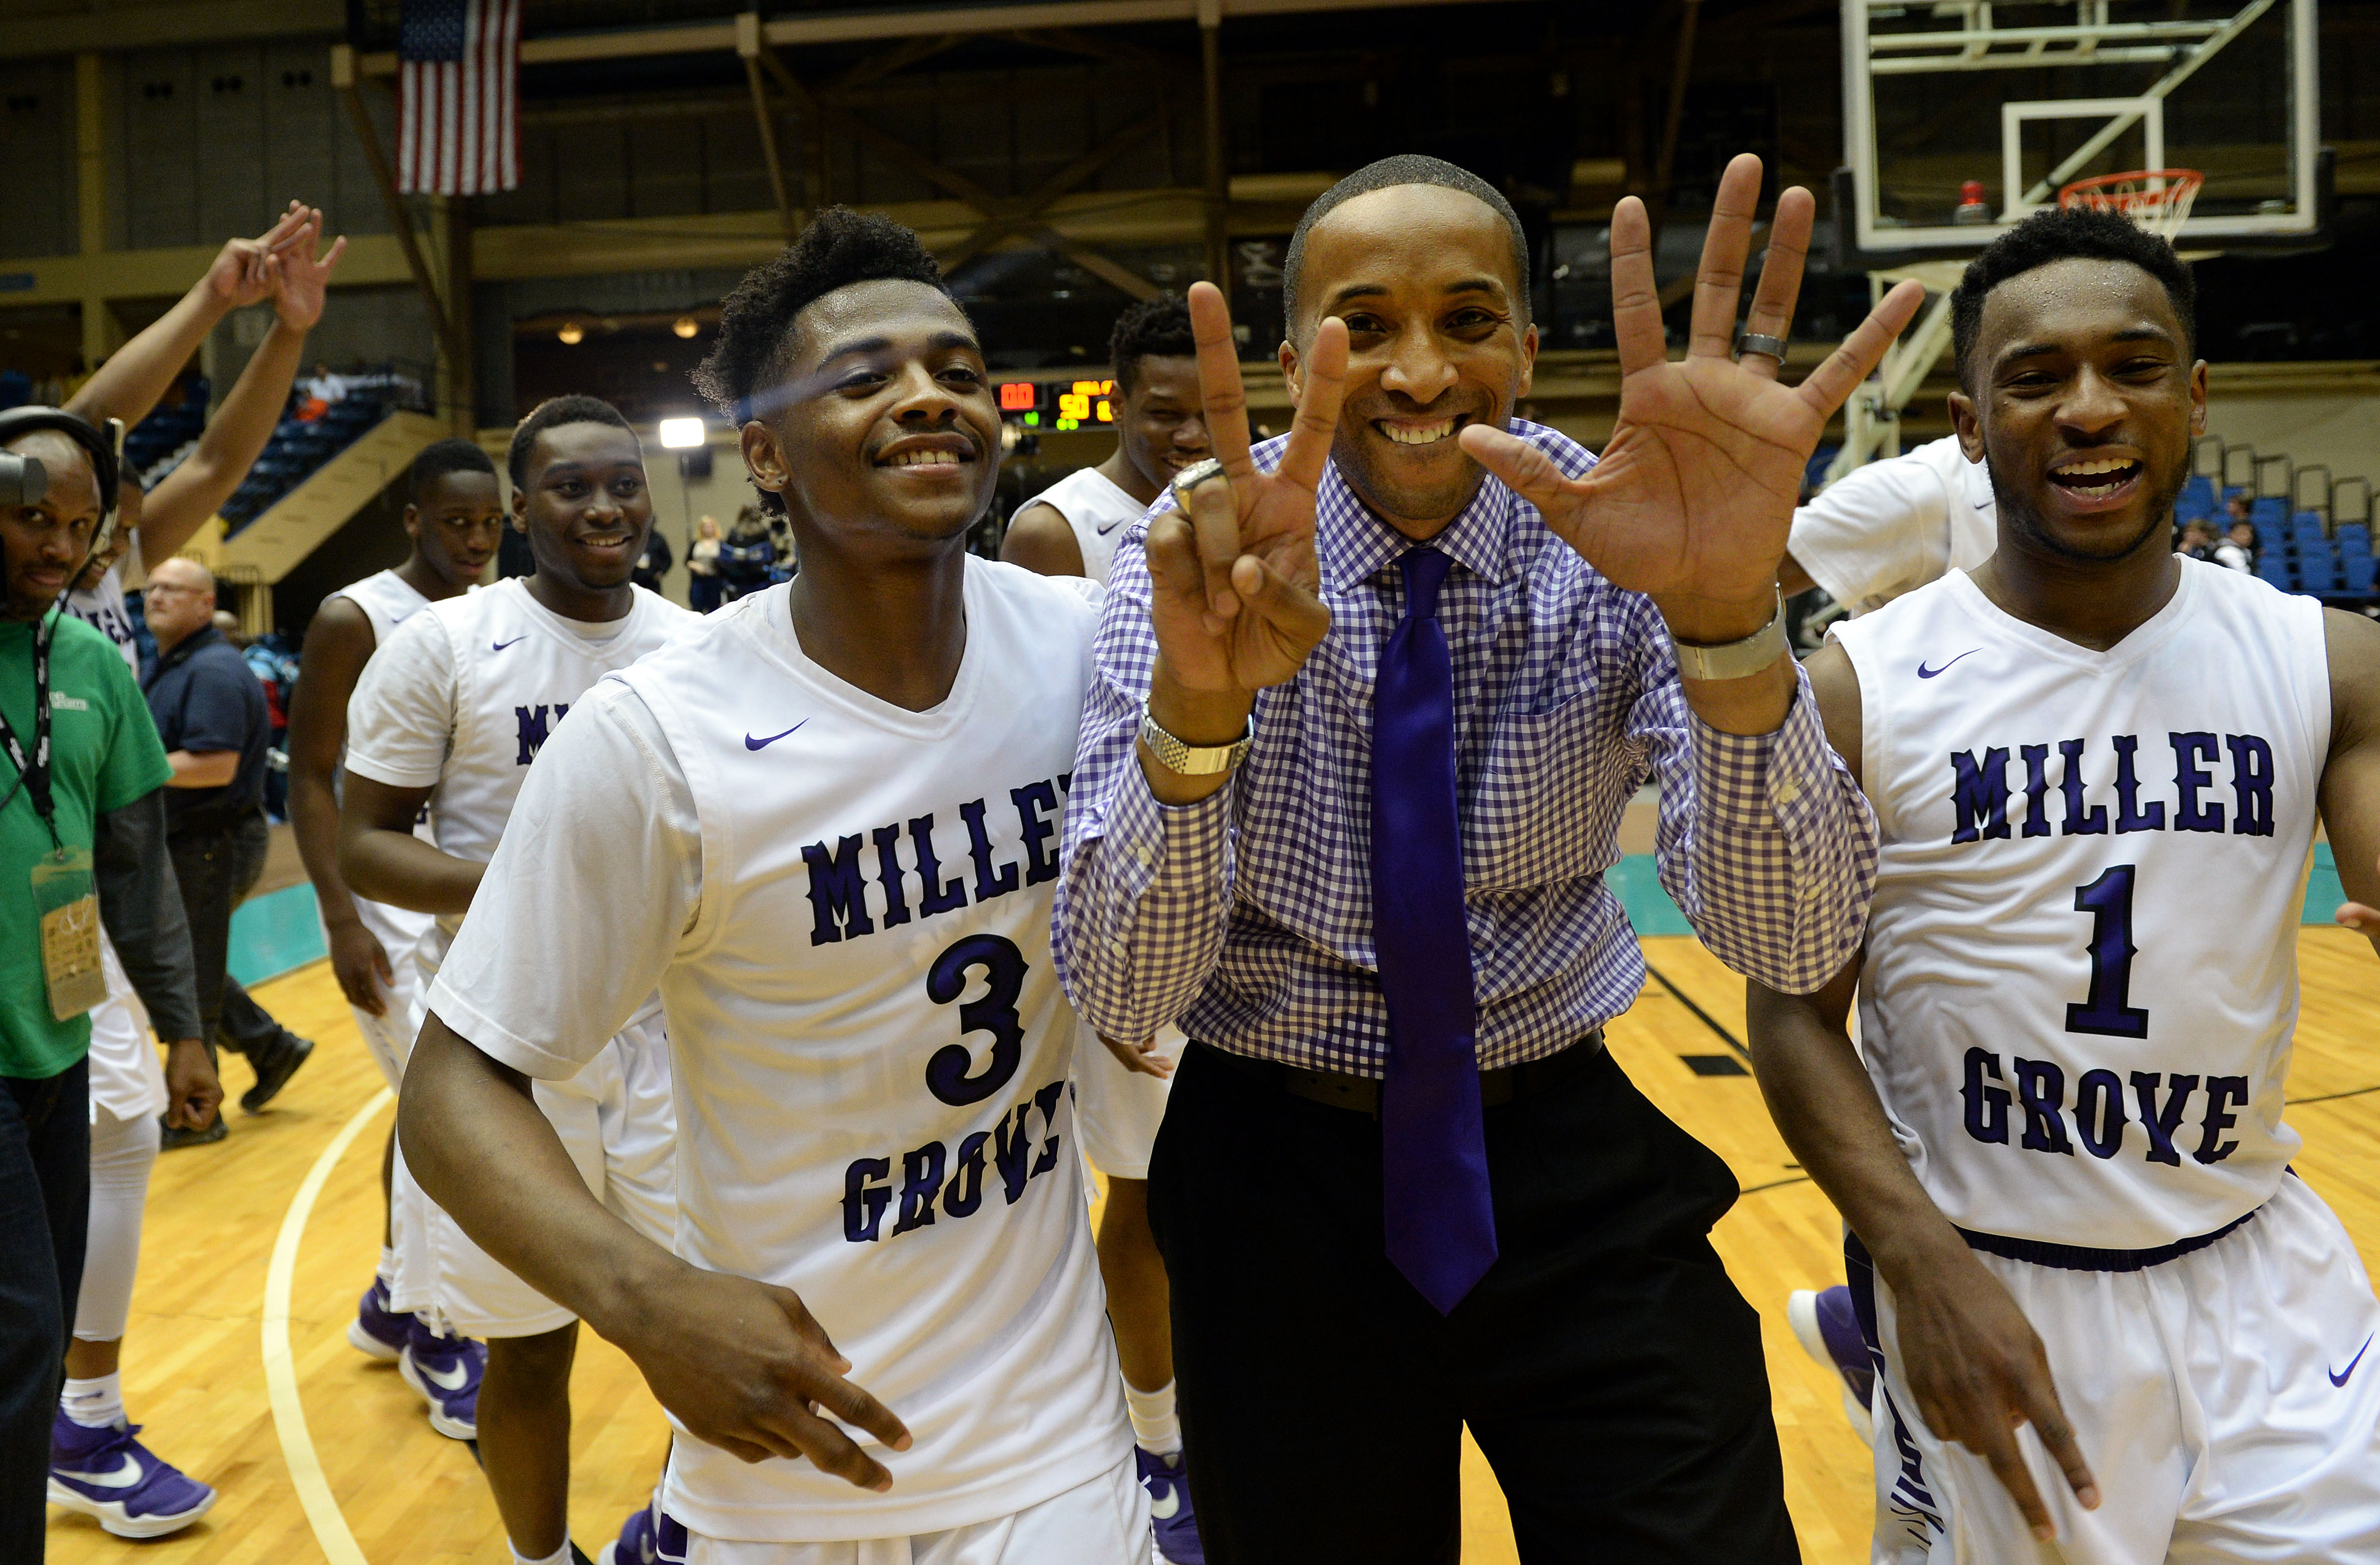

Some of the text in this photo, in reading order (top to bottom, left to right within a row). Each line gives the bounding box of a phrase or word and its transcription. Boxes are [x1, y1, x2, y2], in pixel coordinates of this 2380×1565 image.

[515, 703, 569, 766] M
[1950, 732, 2275, 845] MILLER
[800, 770, 1072, 946] MILLE
[925, 934, 1030, 1107] 3
[2065, 864, 2149, 1039] 1
[1959, 1046, 2249, 1167] GROVE
